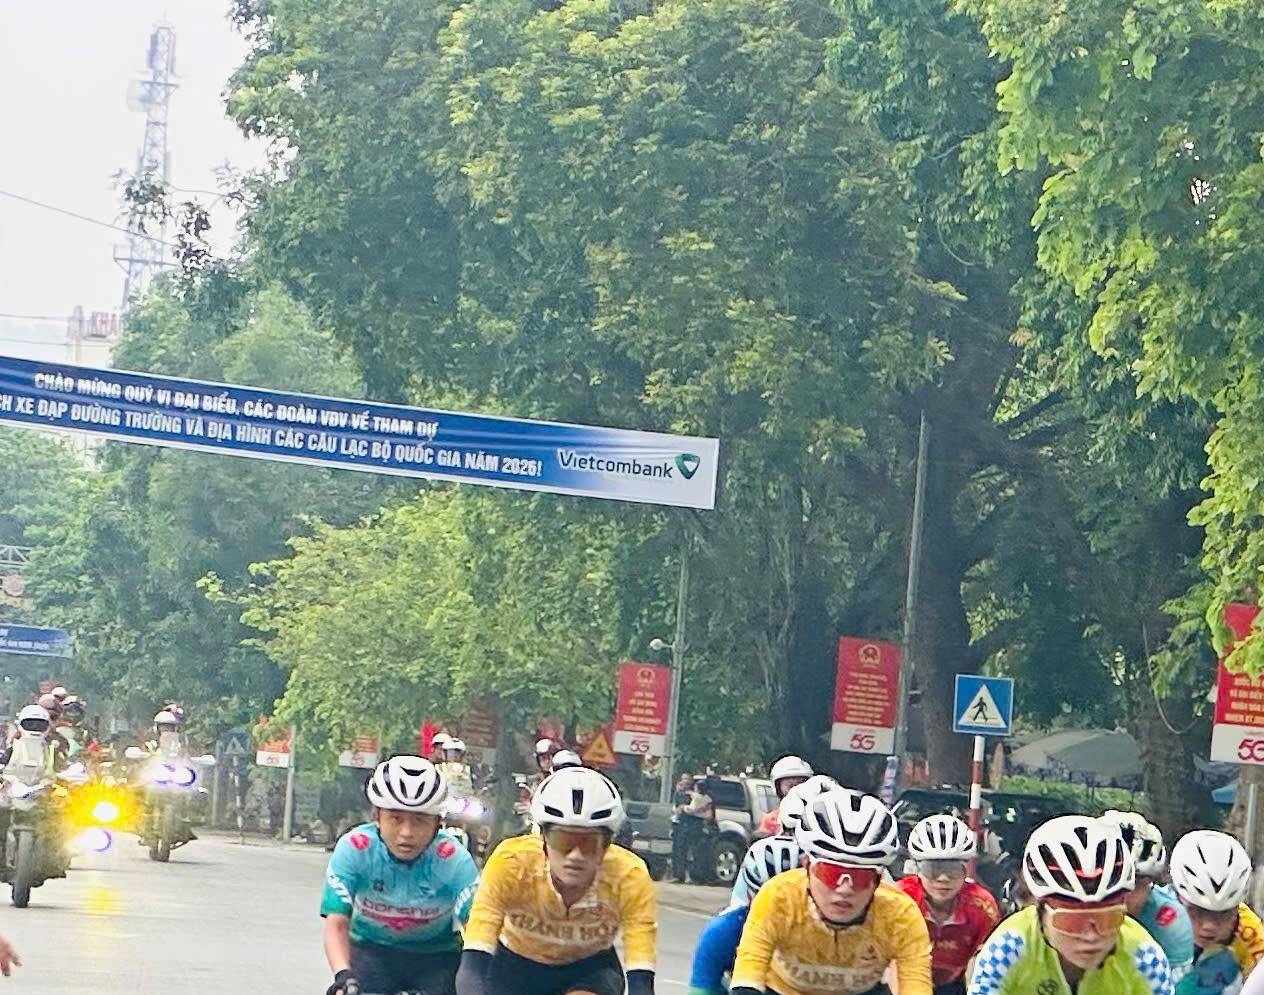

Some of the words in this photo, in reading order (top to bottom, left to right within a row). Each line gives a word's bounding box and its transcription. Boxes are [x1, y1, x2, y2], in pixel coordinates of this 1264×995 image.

[34, 372, 75, 392] CHÀO
[243, 399, 274, 419] CÁC
[276, 403, 317, 424] ĐOÀN
[373, 416, 414, 435] THAM
[15, 396, 35, 415] XE
[37, 399, 69, 421] ĐẠP
[71, 402, 122, 426] ĐƯỜNG
[125, 410, 182, 434] TRƯỜNG
[186, 416, 205, 437] VÀ
[207, 421, 232, 443] ĐỊA
[236, 423, 272, 446] HÌNH
[275, 426, 305, 449] CÁC
[307, 431, 338, 453] CÂU
[341, 438, 369, 459] LẠC
[371, 439, 392, 463] BỘ
[394, 441, 434, 465] QUỐC
[437, 449, 462, 468] GIA
[465, 451, 499, 472] NĂM
[559, 451, 673, 479] Vietcombank
[850, 734, 875, 750] 5G
